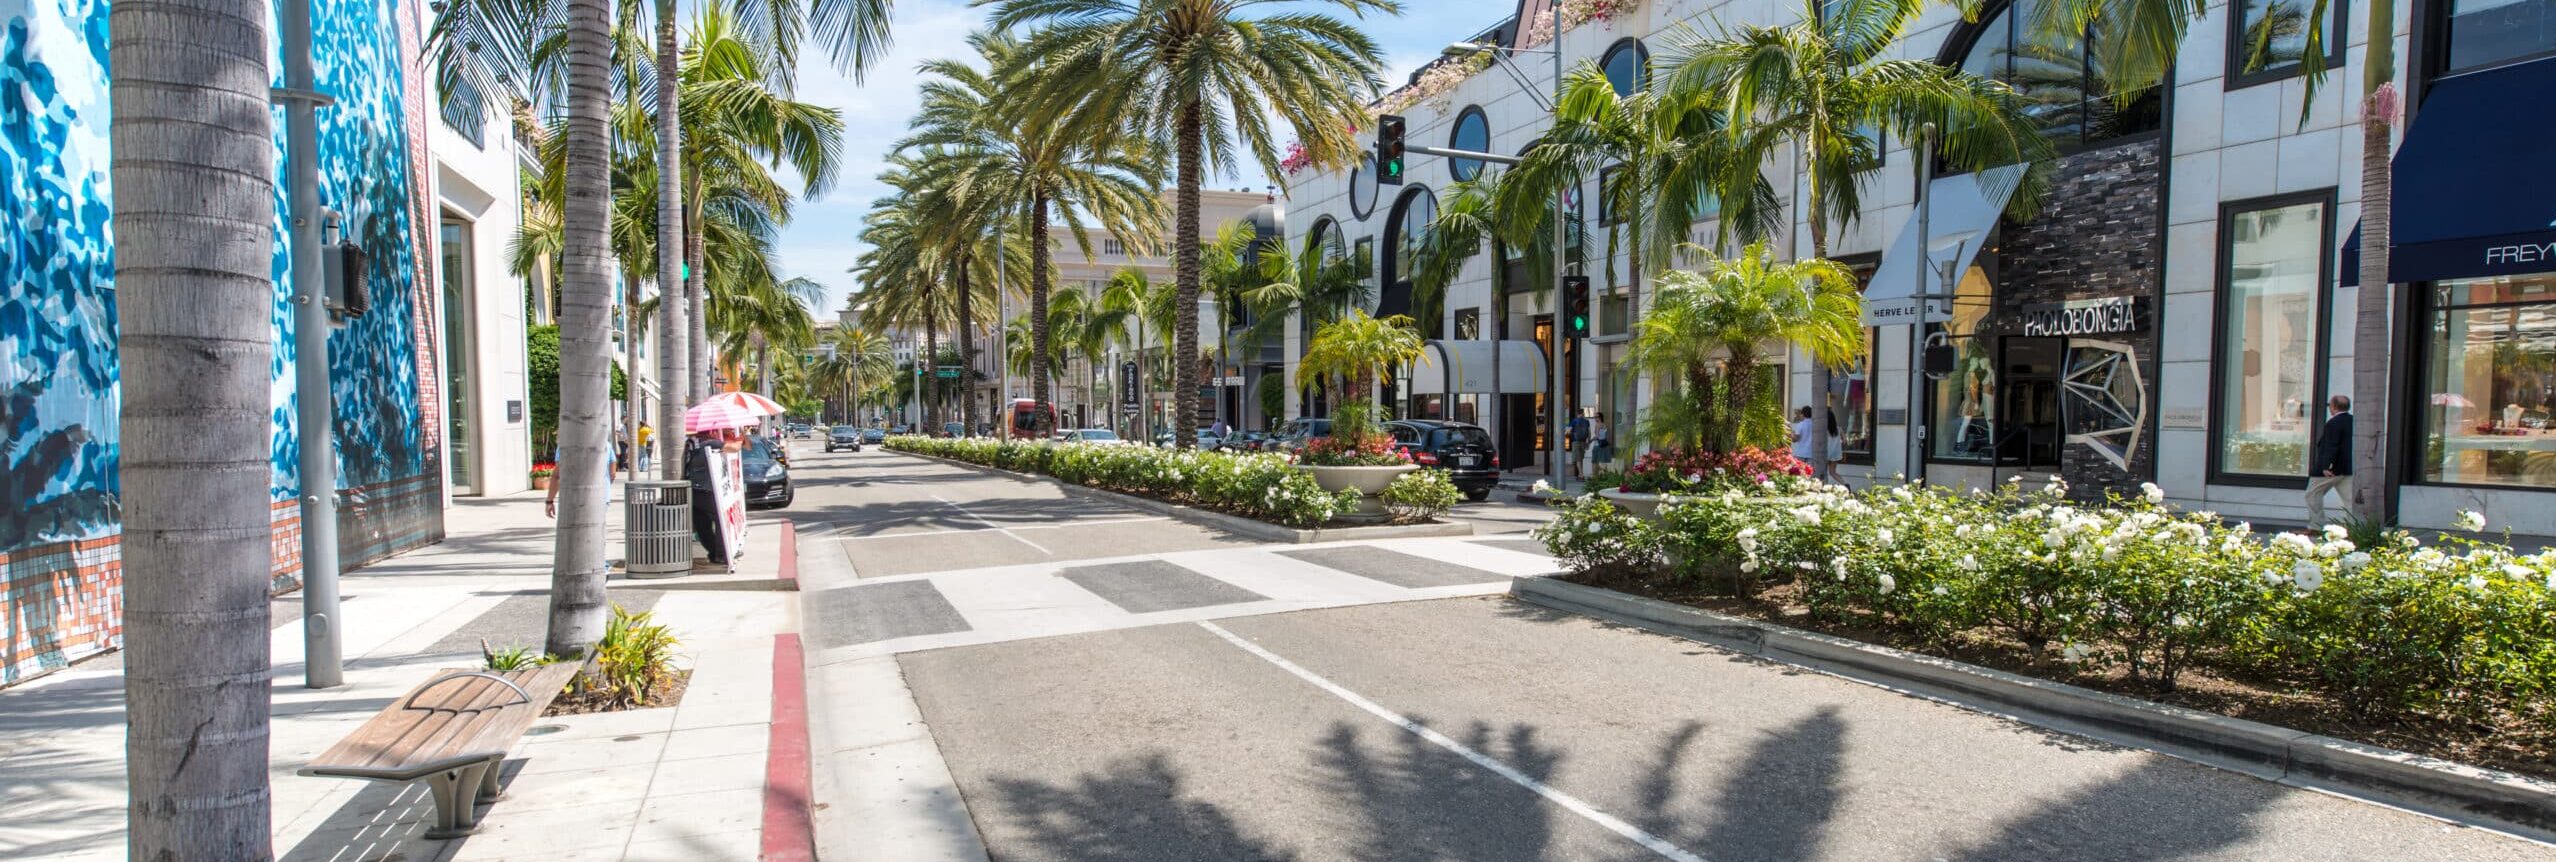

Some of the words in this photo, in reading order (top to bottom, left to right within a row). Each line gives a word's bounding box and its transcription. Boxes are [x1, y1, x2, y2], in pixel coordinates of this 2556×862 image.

[2486, 242, 2556, 265] FREY
[1874, 308, 1902, 317] HERVE
[1904, 305, 1934, 315] LER
[2025, 304, 2135, 336] PAOLOBONGIA
